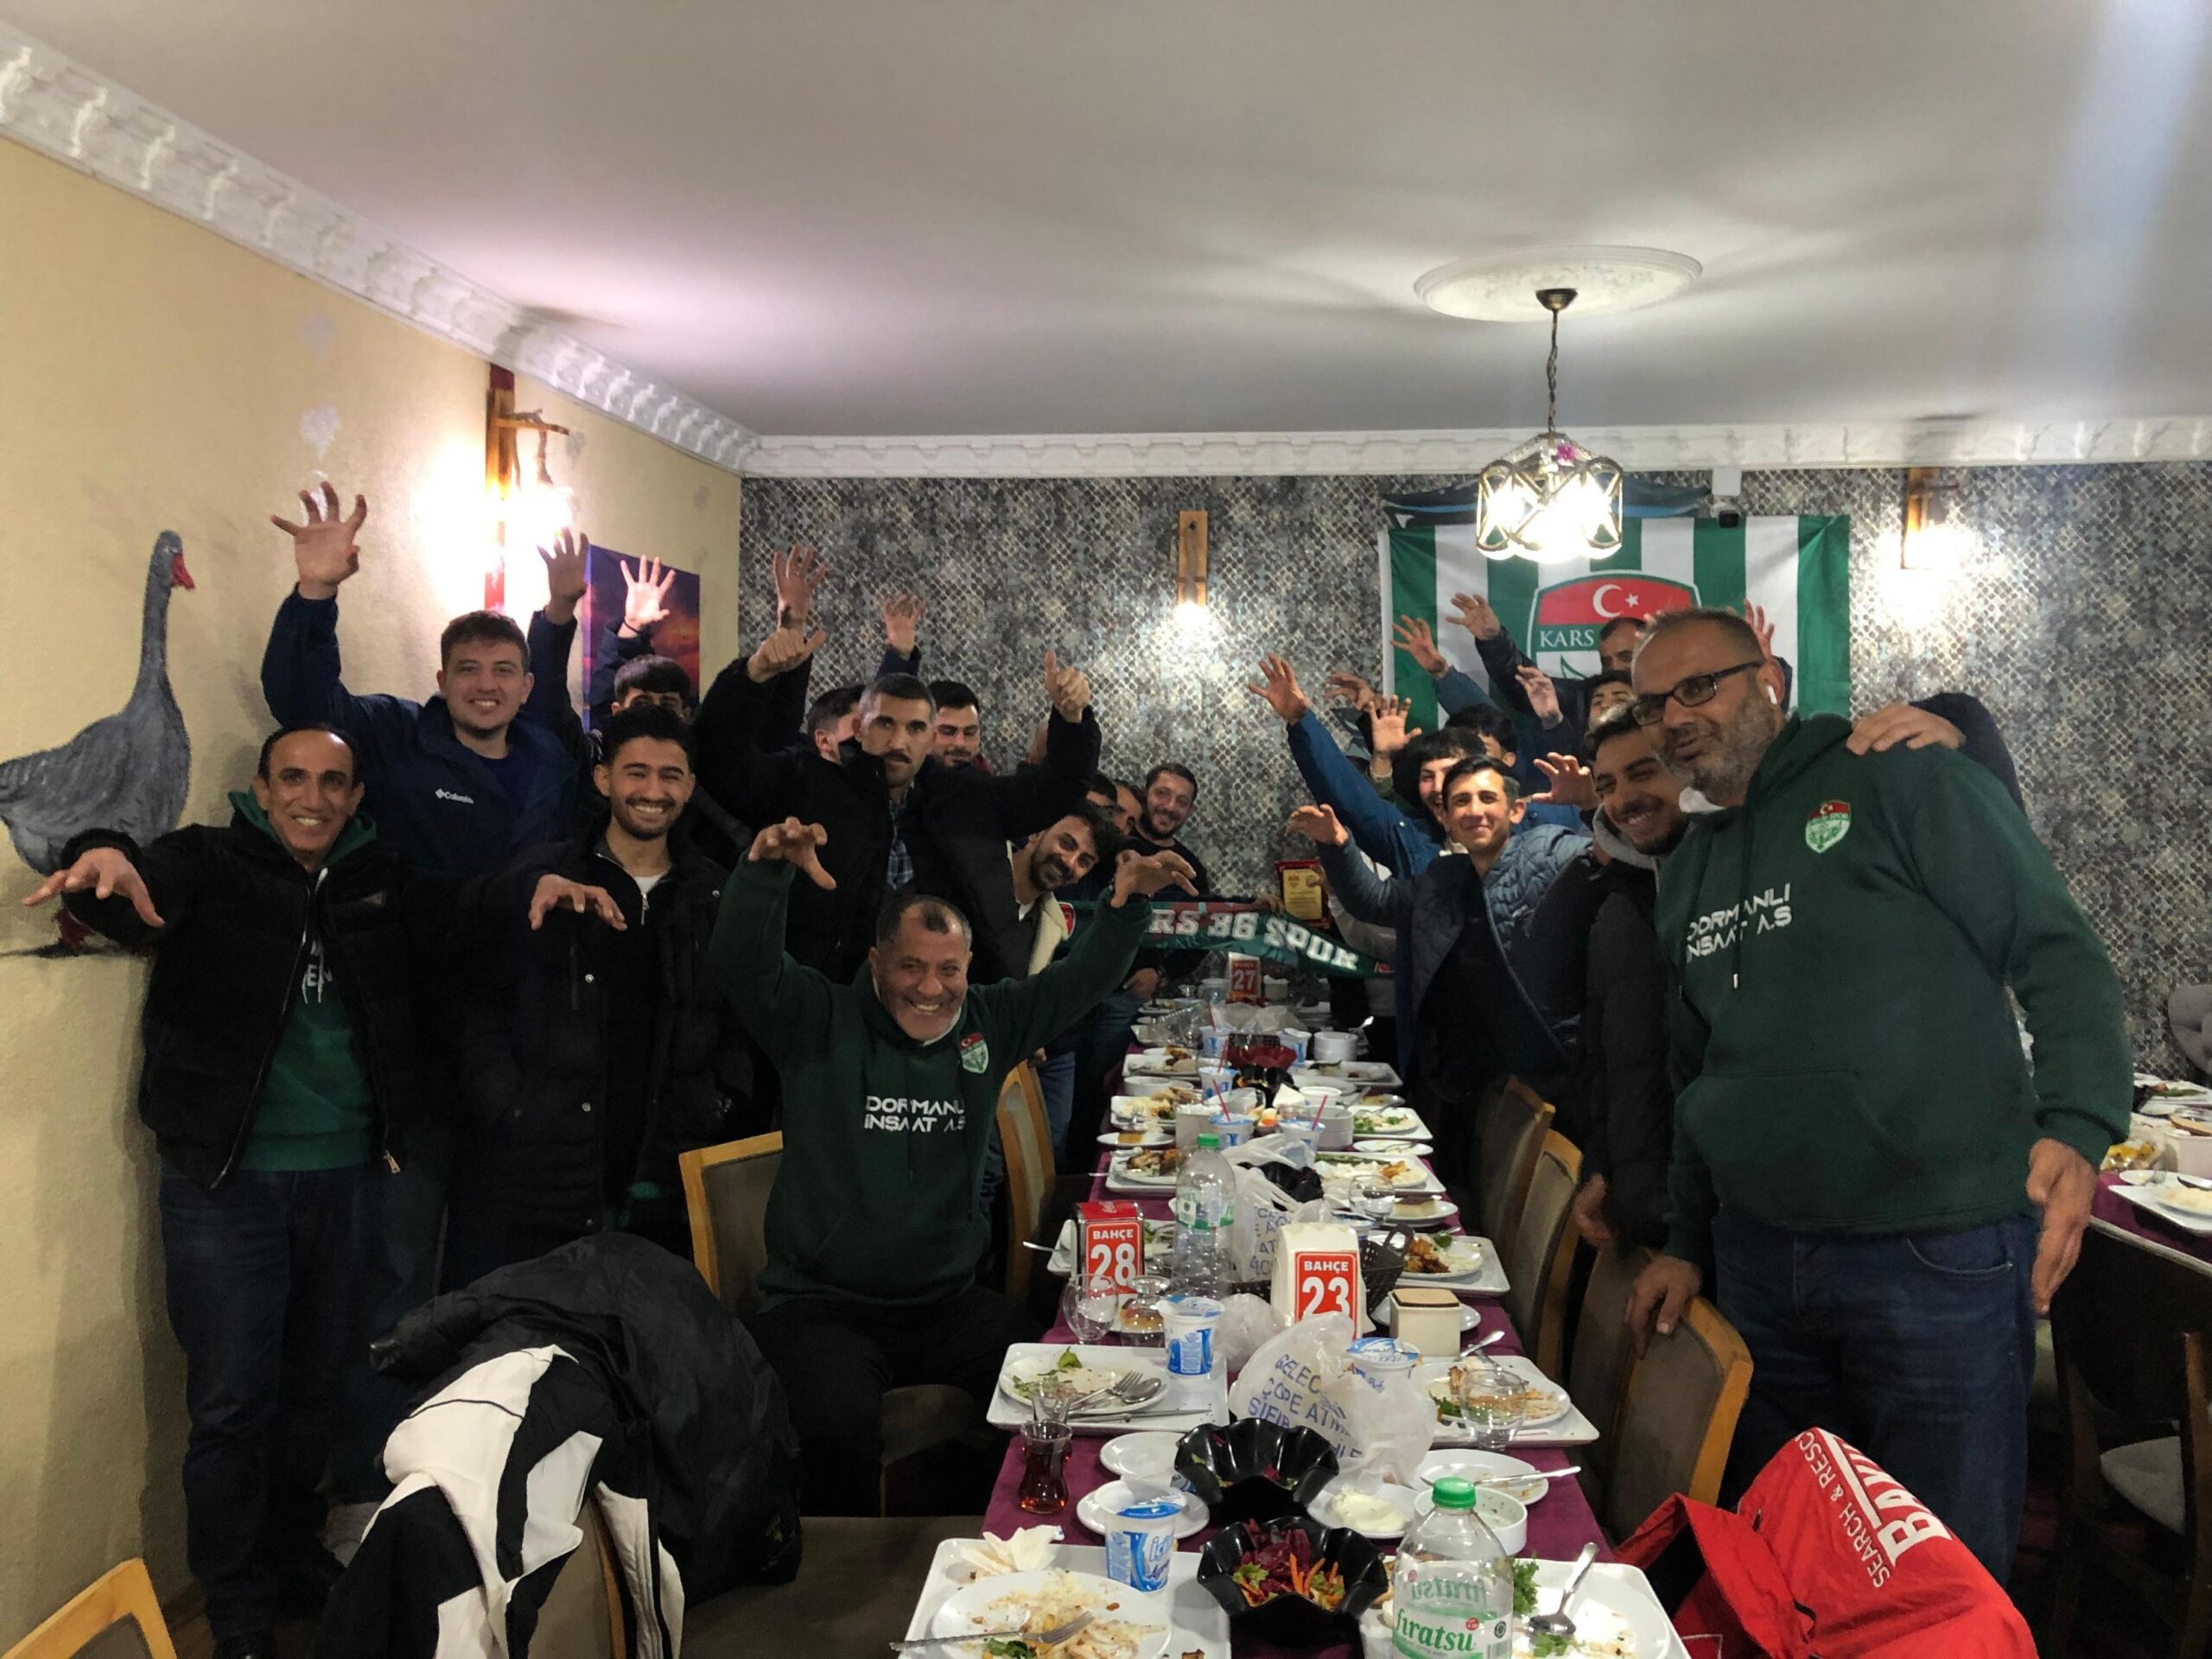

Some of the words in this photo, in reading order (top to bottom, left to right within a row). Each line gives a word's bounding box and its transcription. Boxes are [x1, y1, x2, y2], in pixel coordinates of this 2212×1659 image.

[1540, 629, 1594, 647] KARS
[1147, 909, 1199, 937] RS
[1232, 969, 1255, 991] 27
[1092, 1229, 1134, 1241] BAHÇE
[1090, 1243, 1136, 1291] 28
[1303, 1261, 1349, 1274] BAHÇE
[1301, 1276, 1350, 1322] 23
[1795, 1431, 1836, 1489] RESC
[1829, 1483, 1844, 1503] &
[1839, 1502, 1891, 1588] SEARCH
